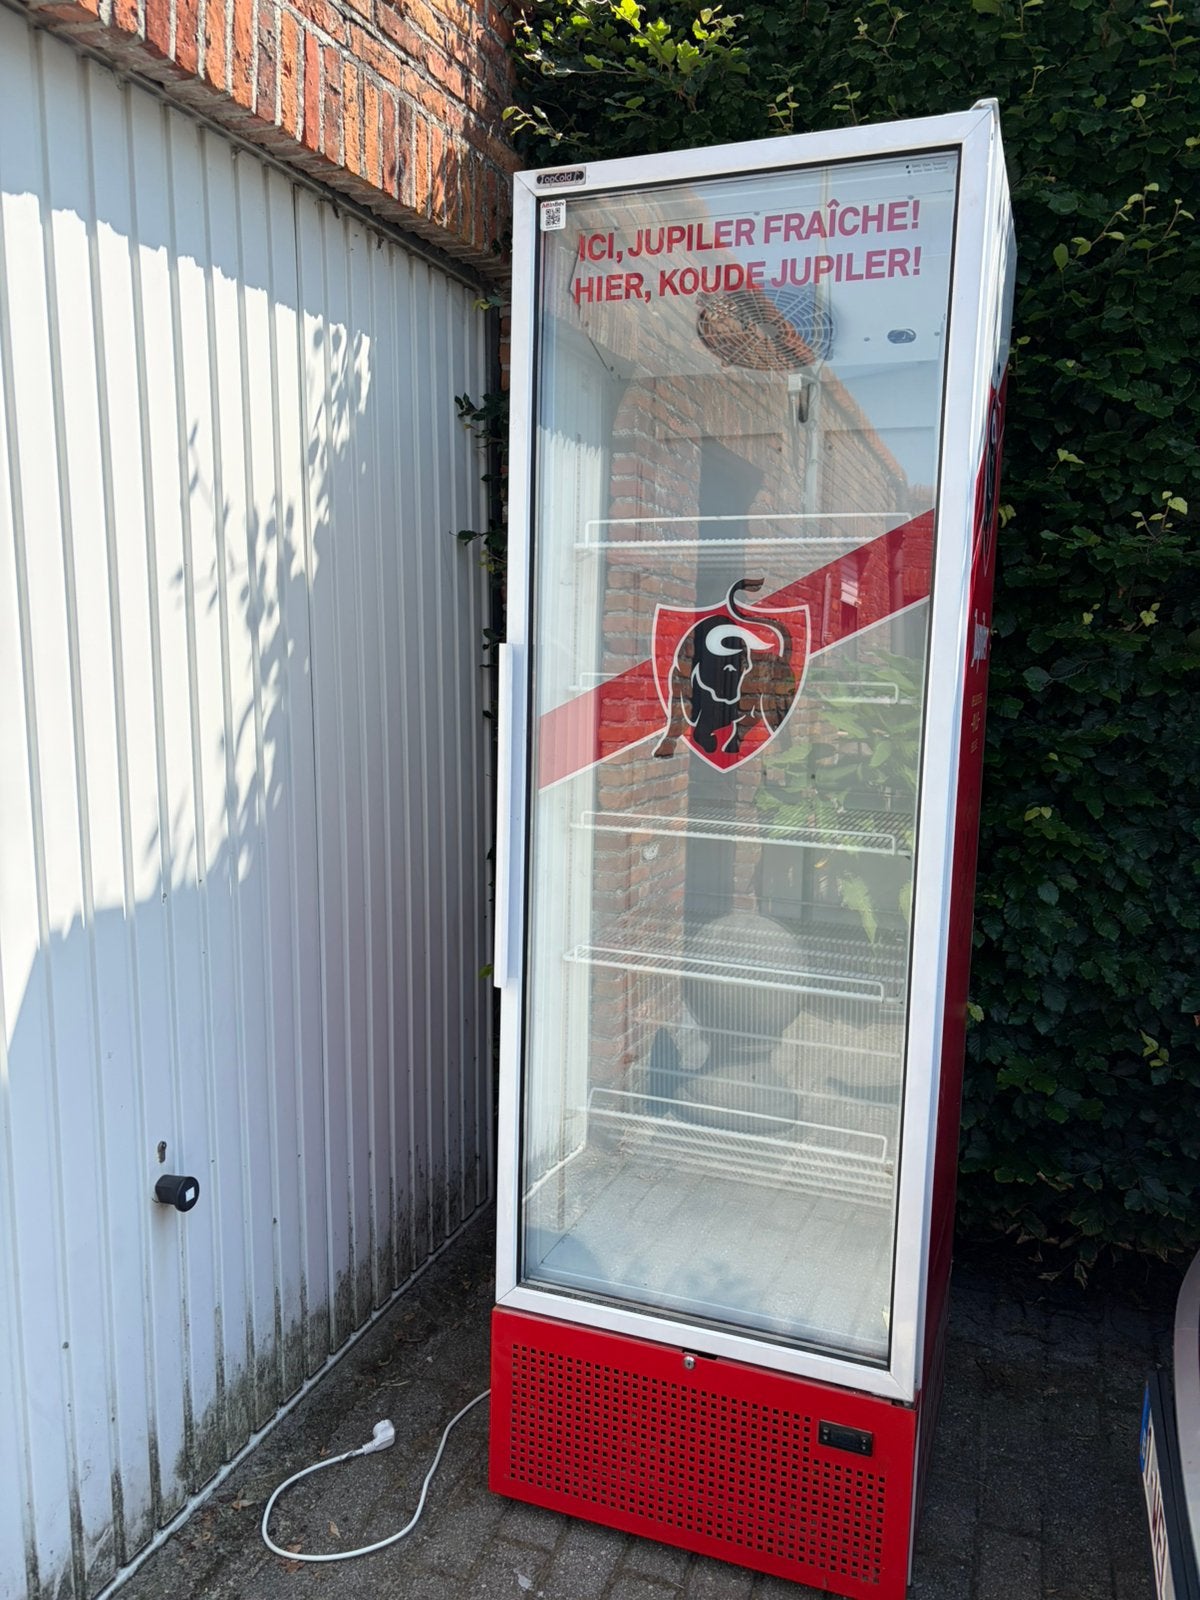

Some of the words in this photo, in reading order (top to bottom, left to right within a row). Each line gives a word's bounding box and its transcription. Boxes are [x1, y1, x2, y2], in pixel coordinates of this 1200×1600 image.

[579, 232, 623, 263] ICI,
[628, 218, 755, 258] JUPILER
[763, 198, 920, 244] FRAÎCHE!
[574, 272, 651, 304] HIER,
[659, 261, 766, 297] KOUDE
[771, 246, 922, 288] JUPILER!
